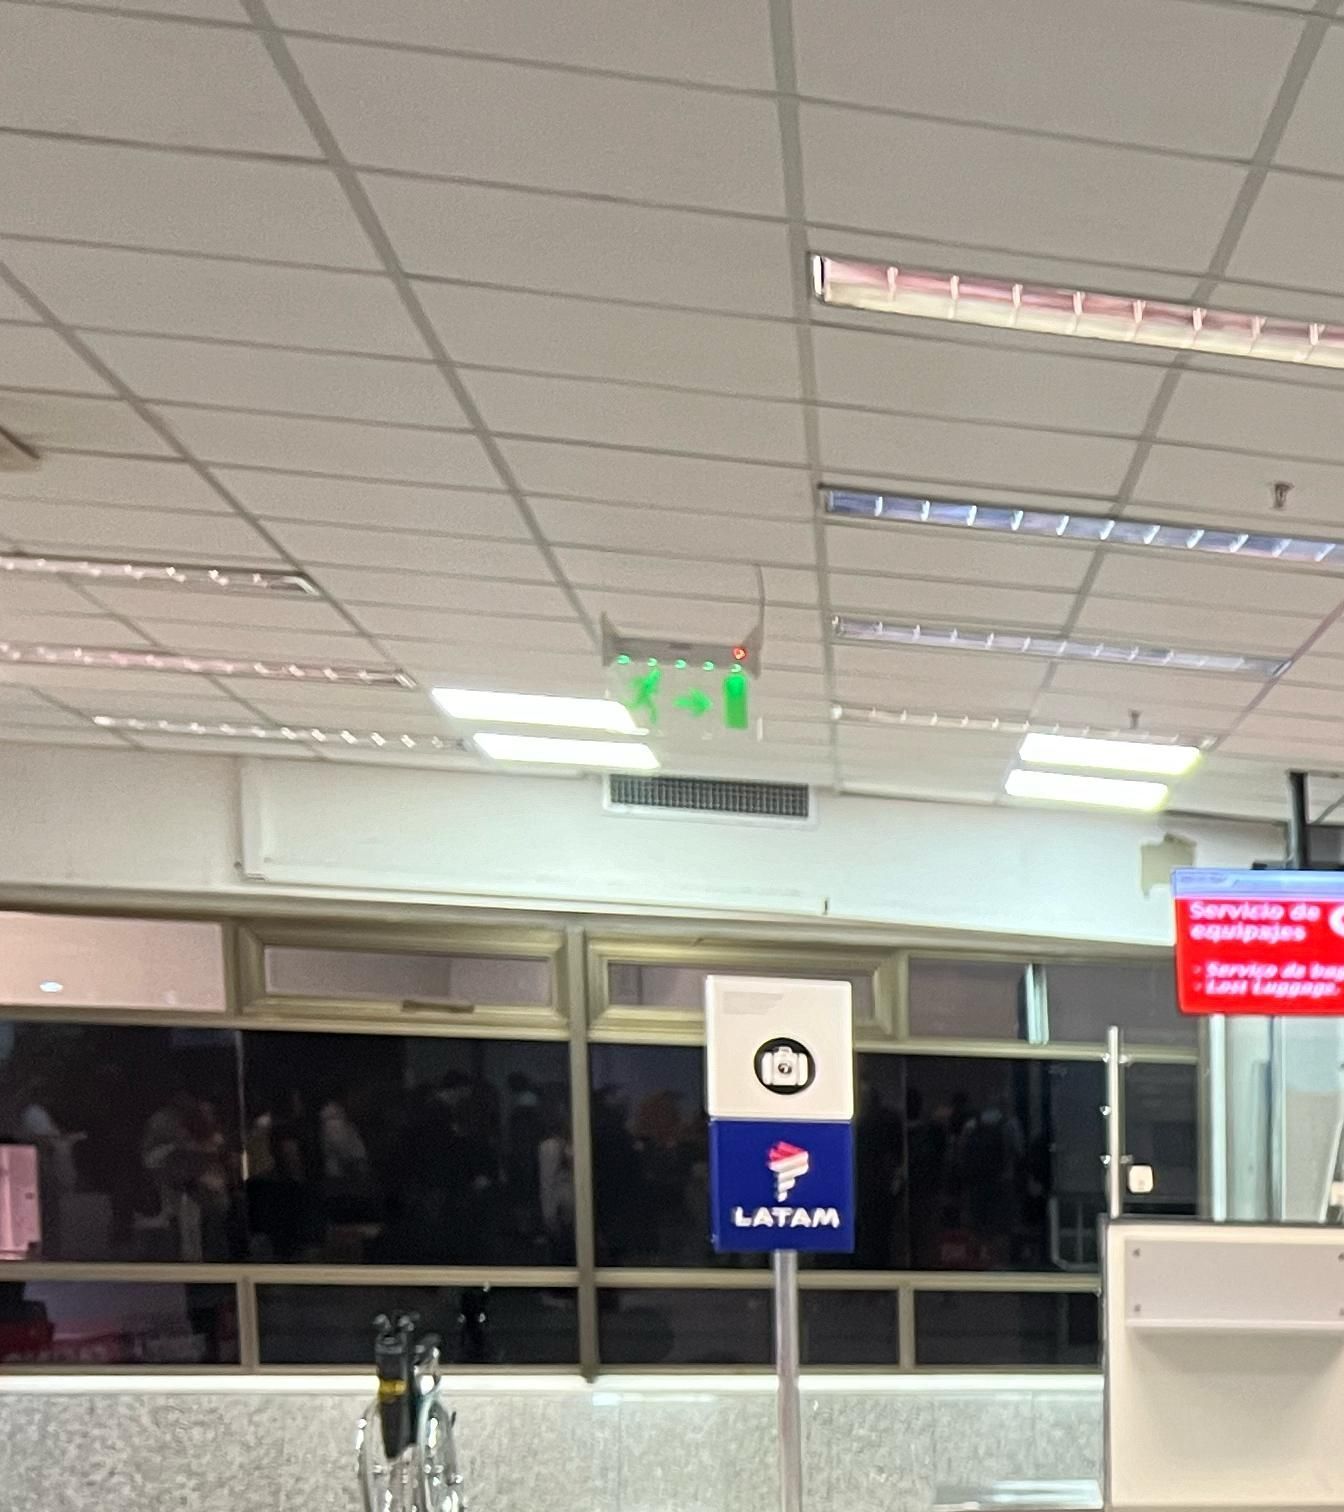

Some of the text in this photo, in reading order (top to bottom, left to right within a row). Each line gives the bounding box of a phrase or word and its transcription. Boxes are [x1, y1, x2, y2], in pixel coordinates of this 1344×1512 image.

[1190, 902, 1321, 921] Servicio de
[1190, 921, 1306, 943] equipajes
[733, 1206, 840, 1228] LATAM
